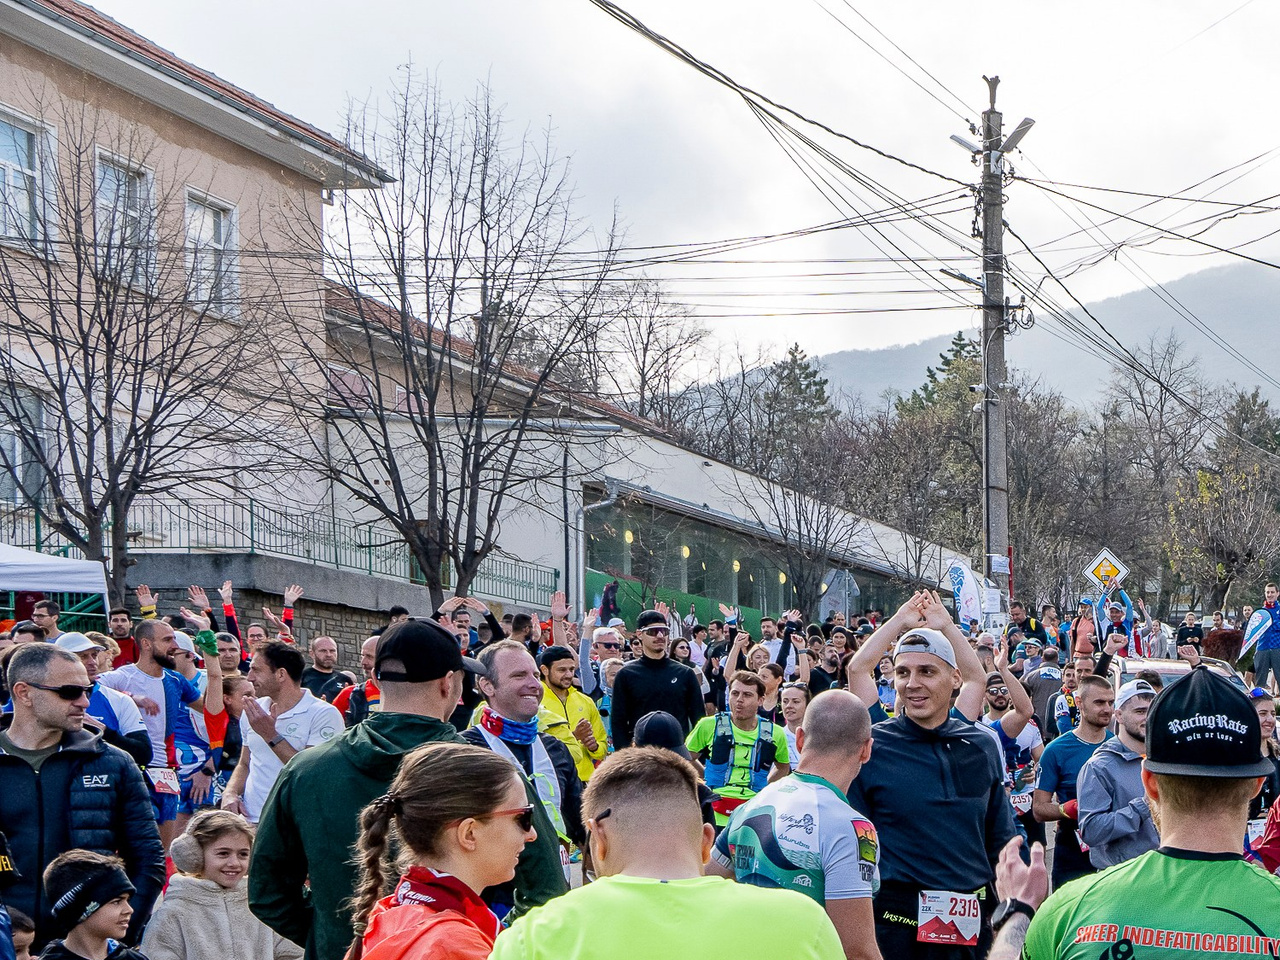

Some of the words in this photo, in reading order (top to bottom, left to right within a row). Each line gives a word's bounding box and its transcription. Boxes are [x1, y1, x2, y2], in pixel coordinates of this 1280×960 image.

[82, 774, 108, 785] EA7
[948, 896, 980, 918] 2319
[883, 910, 919, 927] INSTINC
[1074, 923, 1120, 944] SHEER
